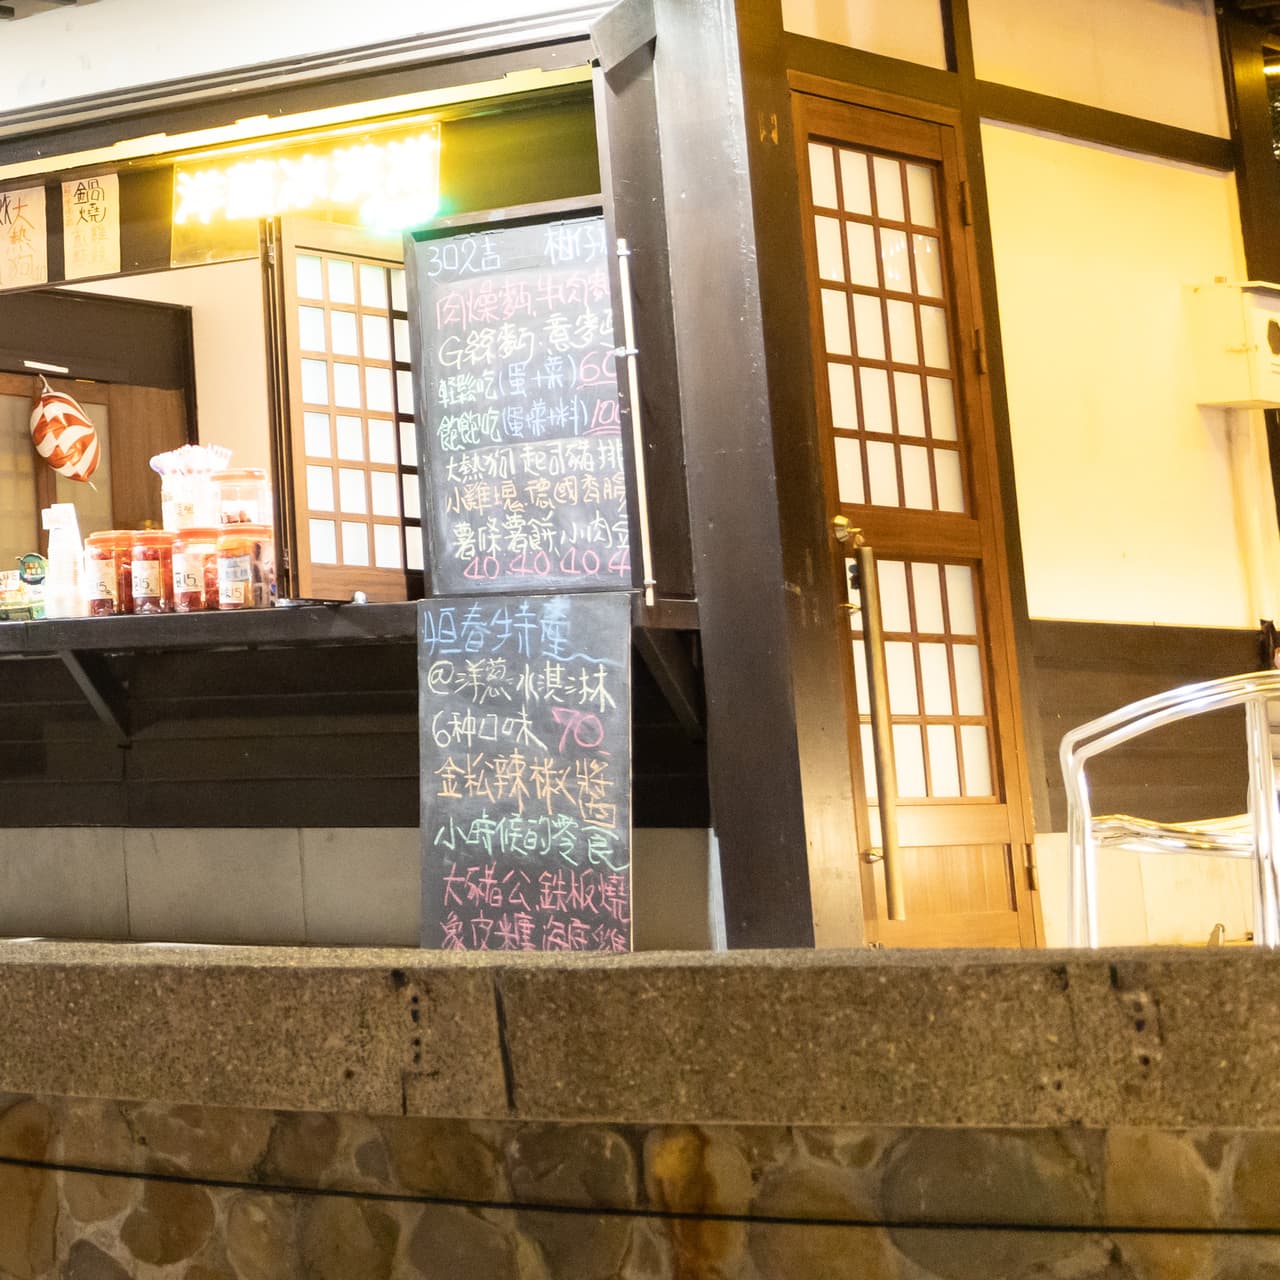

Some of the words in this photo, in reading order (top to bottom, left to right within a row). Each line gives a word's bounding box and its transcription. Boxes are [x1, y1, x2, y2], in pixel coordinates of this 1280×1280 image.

[464, 556, 500, 580] 40
[508, 549, 551, 577] 40
[559, 547, 601, 575] 40
